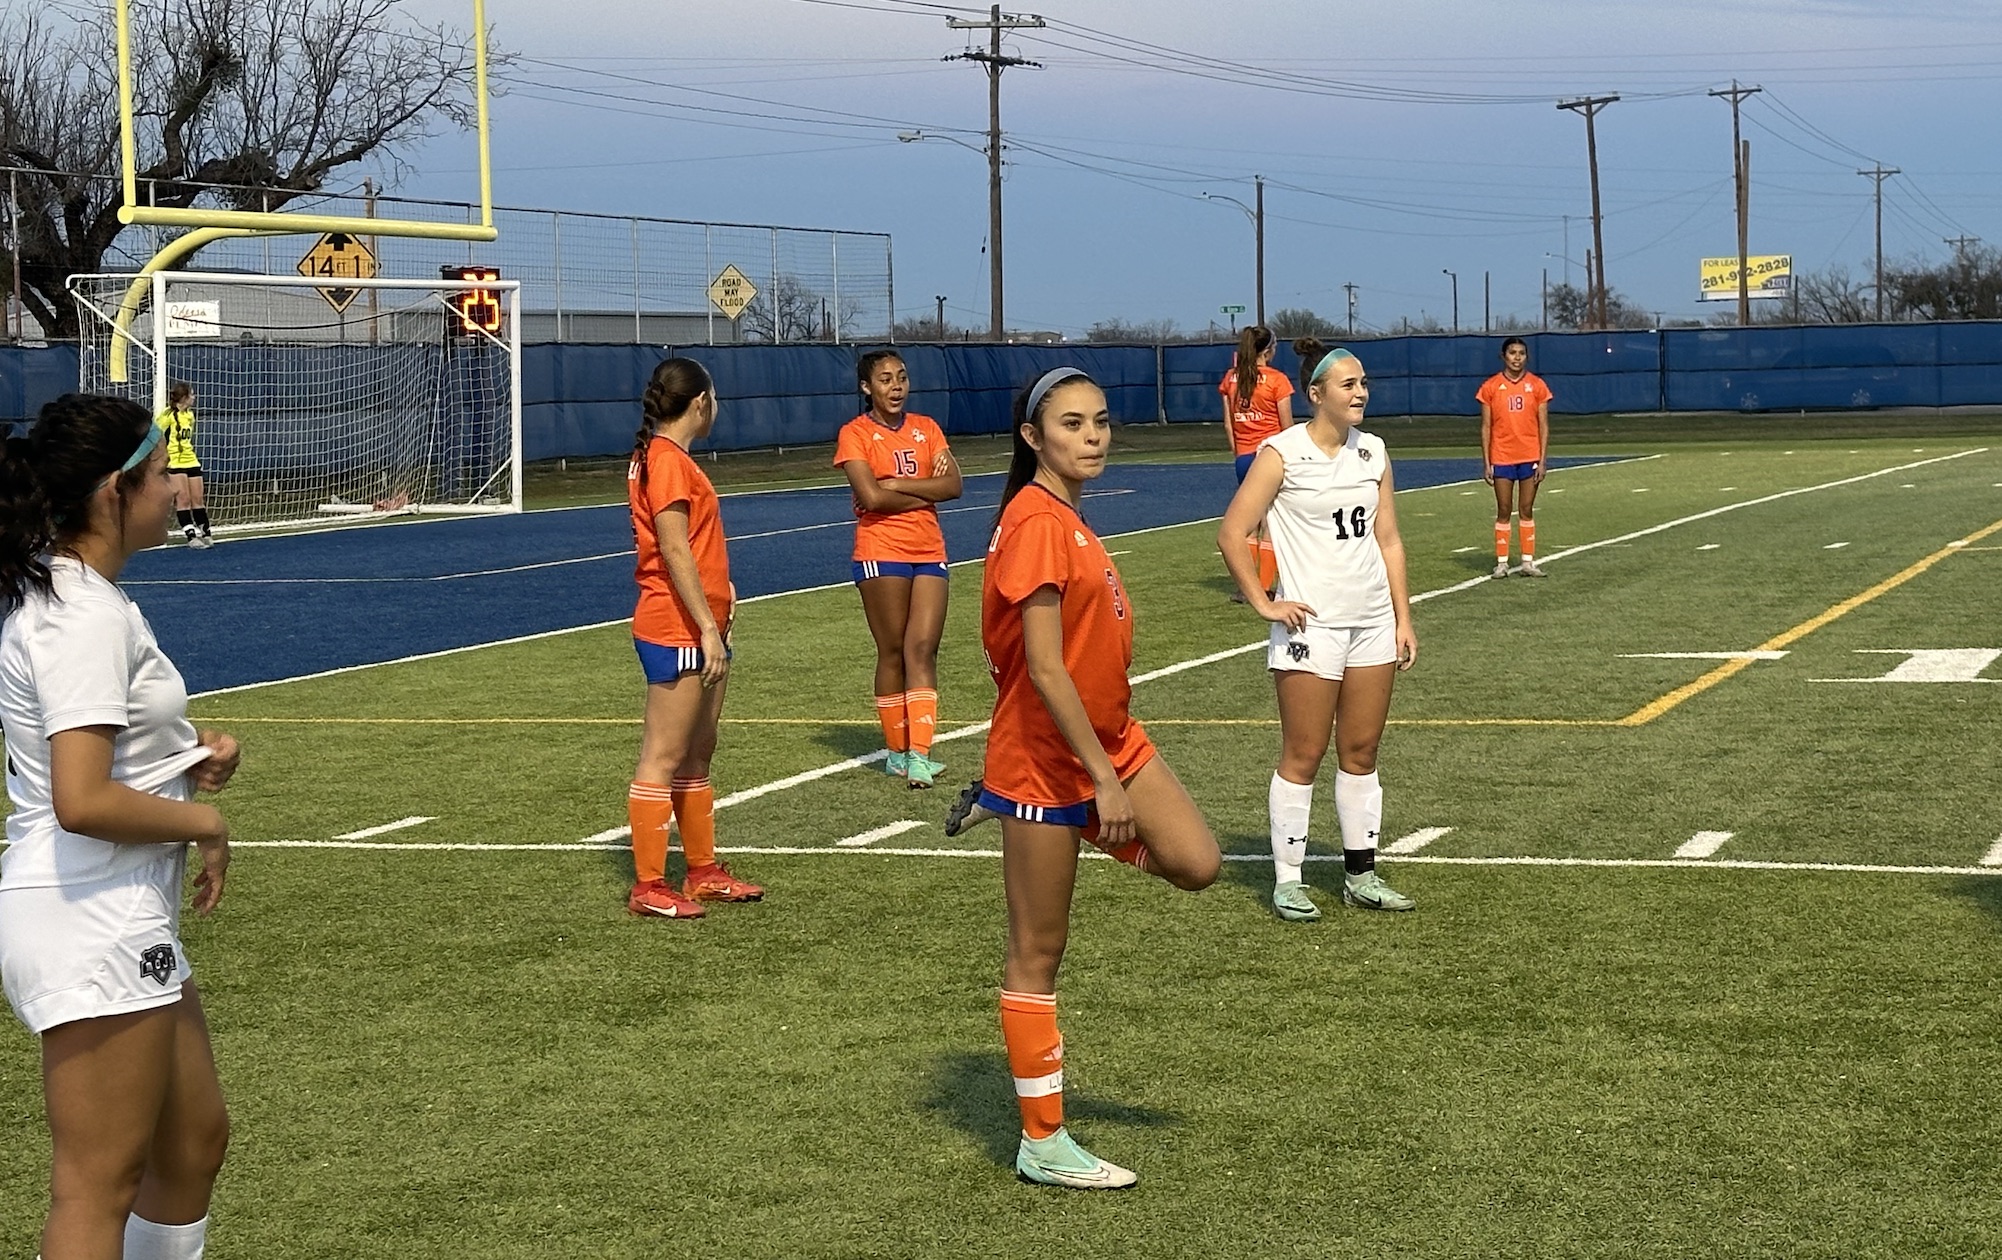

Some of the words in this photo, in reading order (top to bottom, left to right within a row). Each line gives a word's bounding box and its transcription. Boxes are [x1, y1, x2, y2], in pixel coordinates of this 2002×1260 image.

[309, 255, 335, 277] 14
[354, 255, 360, 278] 1
[1702, 257, 1789, 289] 281-92-2828
[1703, 259, 1719, 267] FOR
[1720, 259, 1739, 267] LEAS
[722, 278, 742, 287] ROAD
[725, 288, 738, 297] MAY
[720, 297, 744, 306] FLOOD
[1509, 395, 1524, 412] 18
[893, 449, 918, 477] 15
[1332, 506, 1366, 540] 16
[1105, 568, 1126, 620] 3
